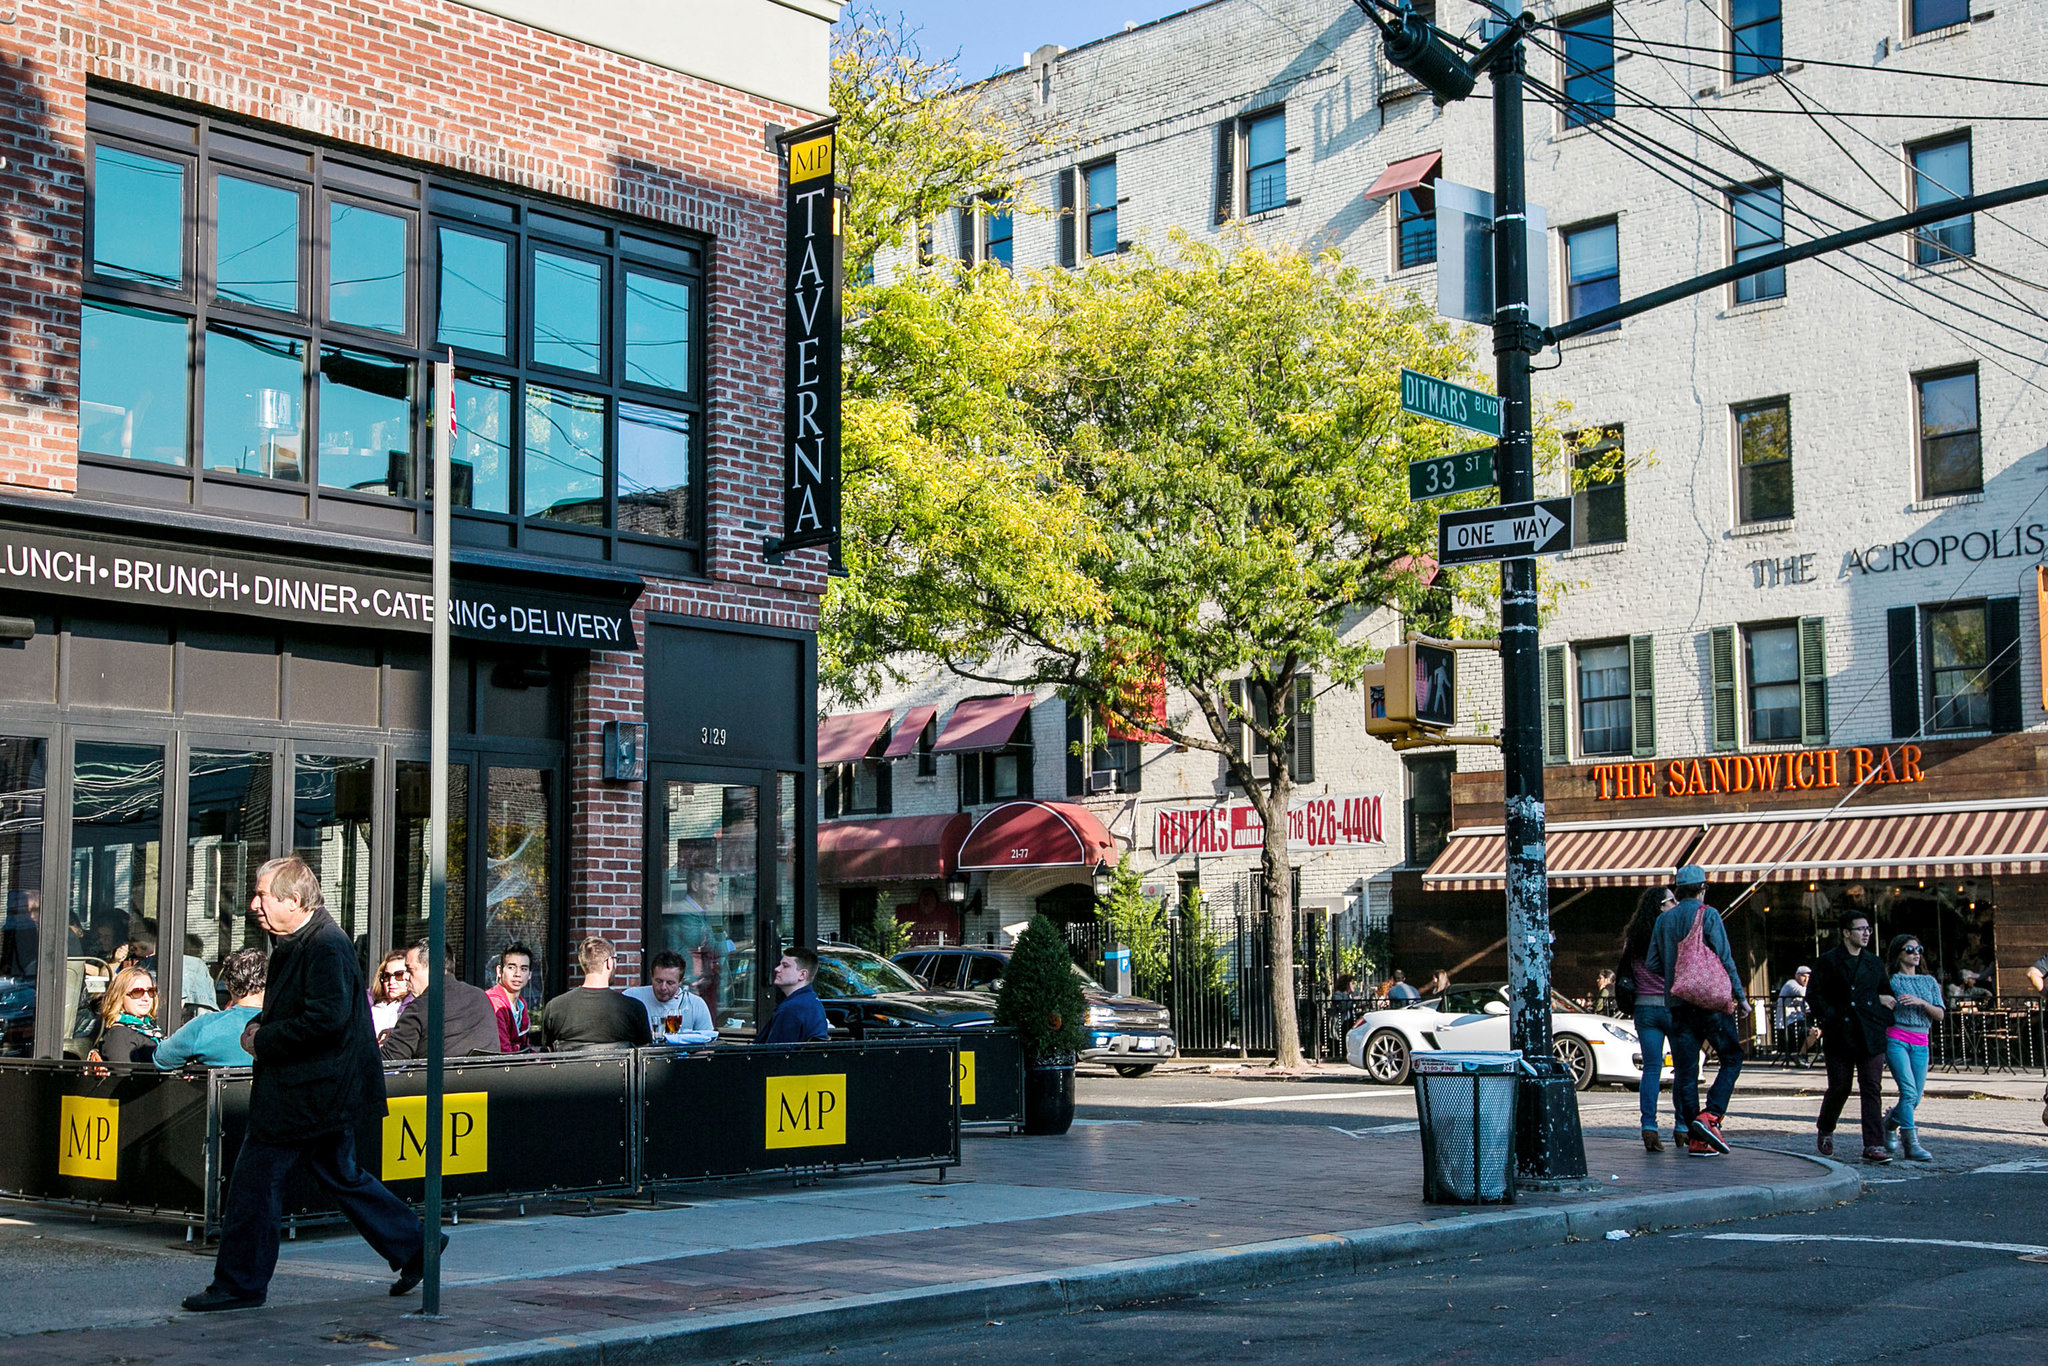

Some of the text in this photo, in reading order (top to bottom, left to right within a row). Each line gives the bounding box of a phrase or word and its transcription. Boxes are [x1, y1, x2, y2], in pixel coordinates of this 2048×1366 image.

[795, 144, 828, 174] MP
[791, 188, 825, 534] TAVERNA
[1405, 374, 1498, 422] DITMARS BLVD
[1425, 455, 1481, 493] 33 ST
[1457, 516, 1552, 547] ONE WAY
[1751, 523, 2046, 587] THE ACROPOLIS
[113, 558, 239, 601] BRUNCH
[254, 575, 360, 615] DINNER
[510, 606, 623, 643] DELIVERY
[701, 726, 727, 746] 3129
[1593, 744, 1925, 800] THE SANDWICH BAR
[1159, 807, 1229, 855] RENTALS
[1286, 796, 1383, 847] 718 626-4400
[1011, 848, 1029, 859] 21-77
[776, 1089, 836, 1133] MP
[67, 1112, 111, 1161] MP
